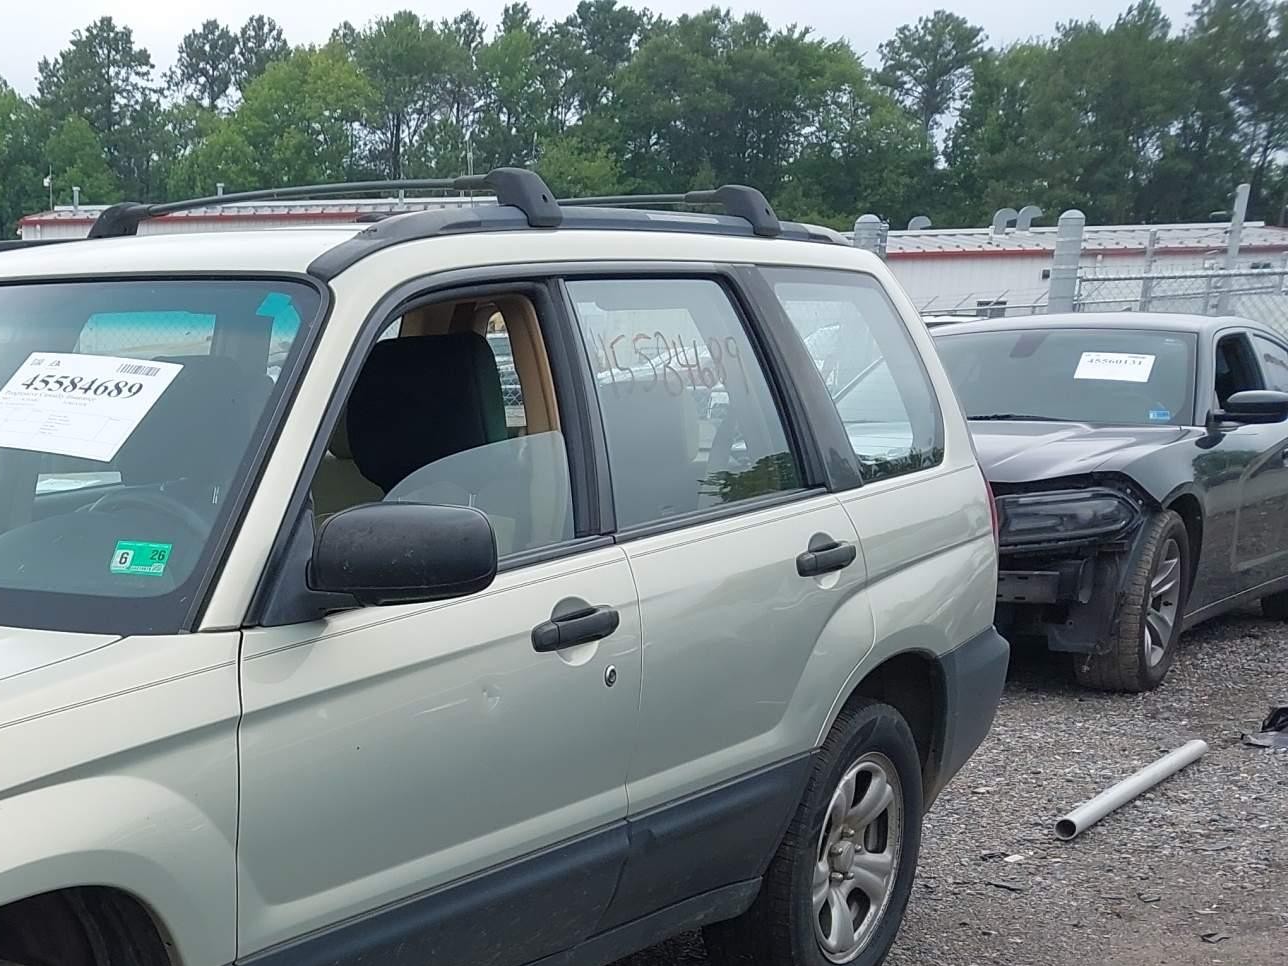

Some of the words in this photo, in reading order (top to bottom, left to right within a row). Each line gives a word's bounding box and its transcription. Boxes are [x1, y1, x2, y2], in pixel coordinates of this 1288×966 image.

[21, 373, 144, 399] 45584689
[118, 551, 130, 565] 6
[149, 549, 167, 561] 26
